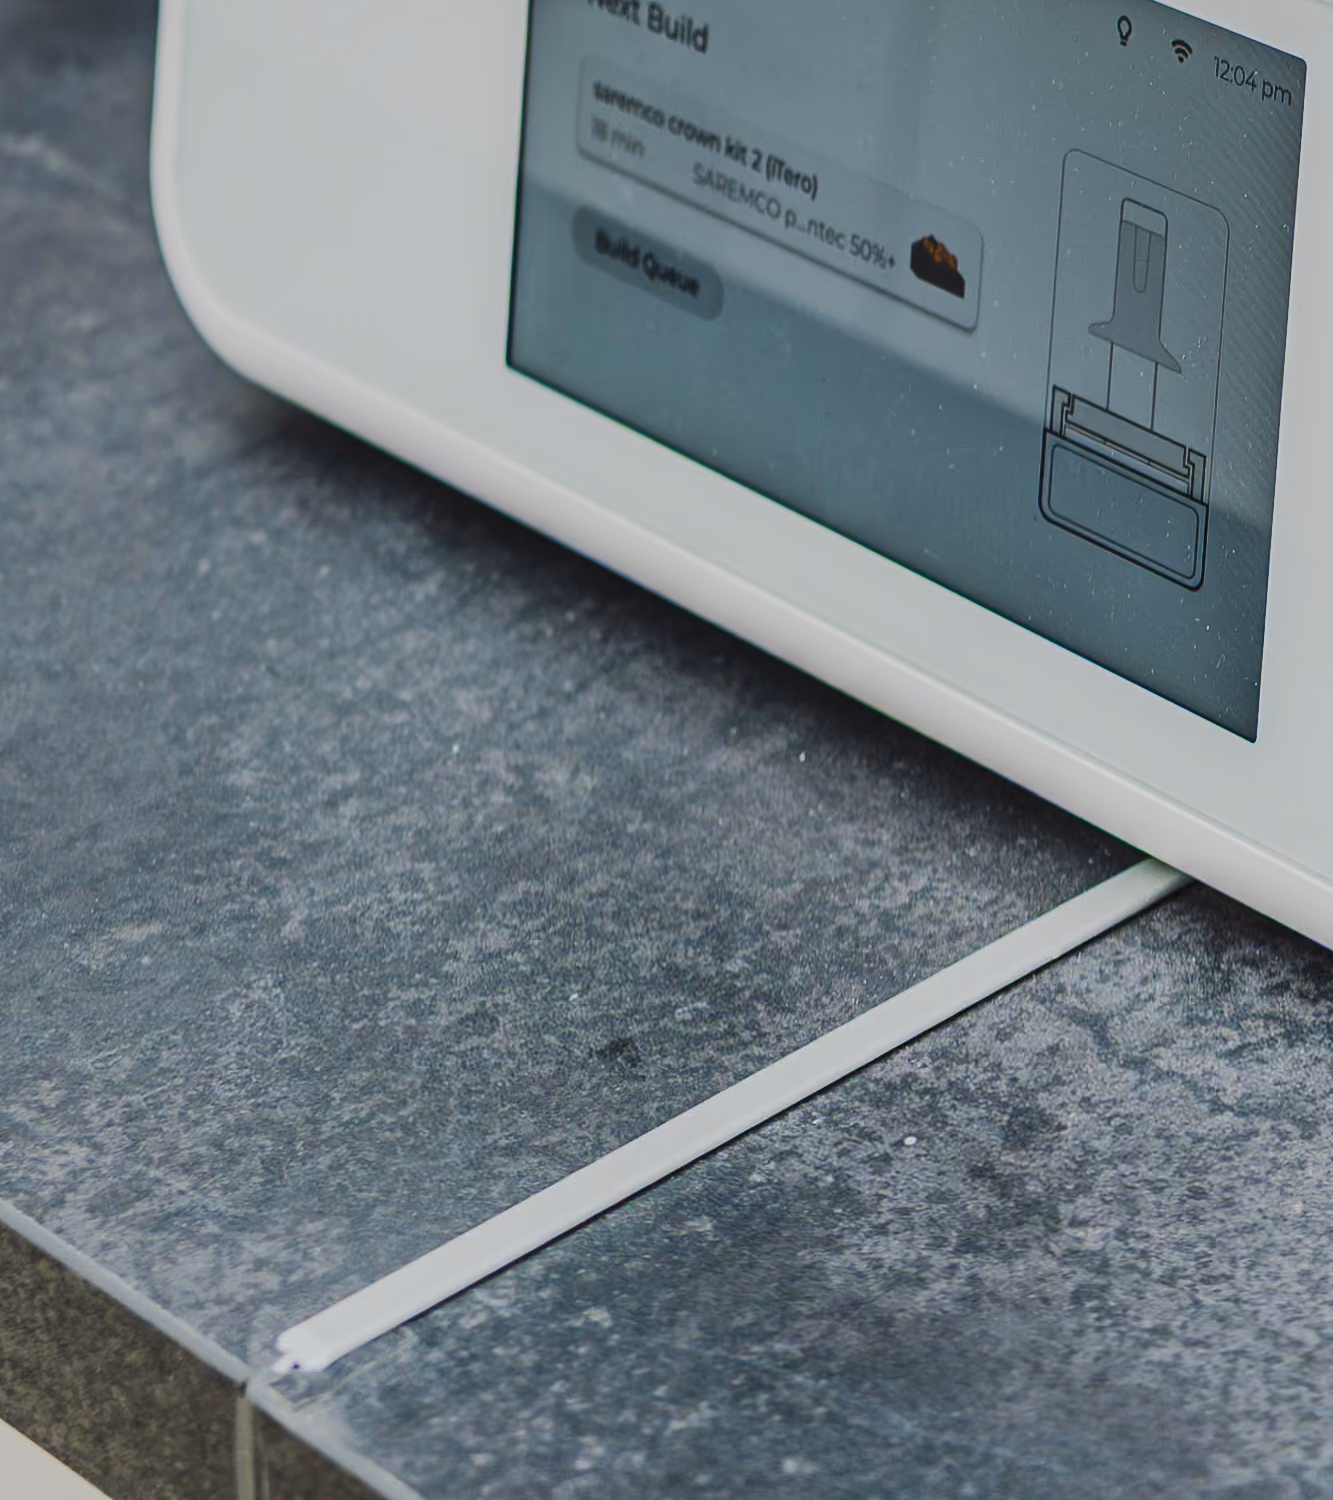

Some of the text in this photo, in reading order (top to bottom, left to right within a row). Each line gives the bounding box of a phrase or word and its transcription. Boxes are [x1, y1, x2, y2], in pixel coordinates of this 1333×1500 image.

[646, 0, 710, 56] Build
[1212, 55, 1293, 107] 12:04 pm
[667, 114, 722, 154] crown
[724, 135, 749, 167] kit
[751, 148, 763, 173] 2
[691, 159, 782, 221] SAREMCO
[594, 226, 640, 270] Build
